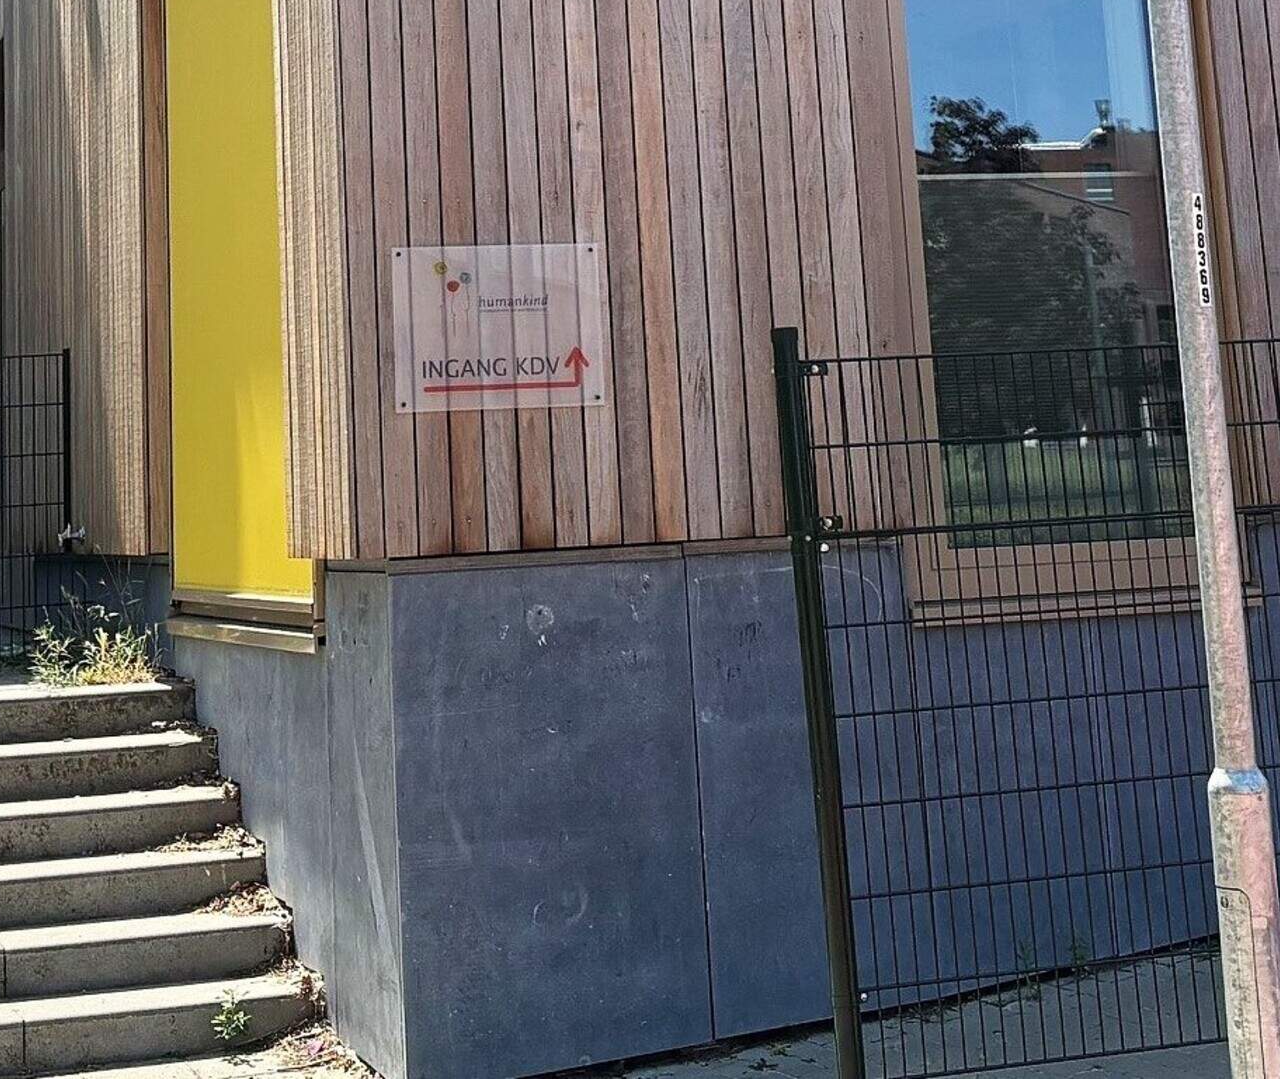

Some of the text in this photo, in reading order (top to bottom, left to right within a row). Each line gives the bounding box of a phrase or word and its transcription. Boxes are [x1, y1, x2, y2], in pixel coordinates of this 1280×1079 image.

[1194, 195, 1210, 304] 488369
[478, 294, 549, 308] humankind
[422, 356, 561, 379] INGANG KDV
